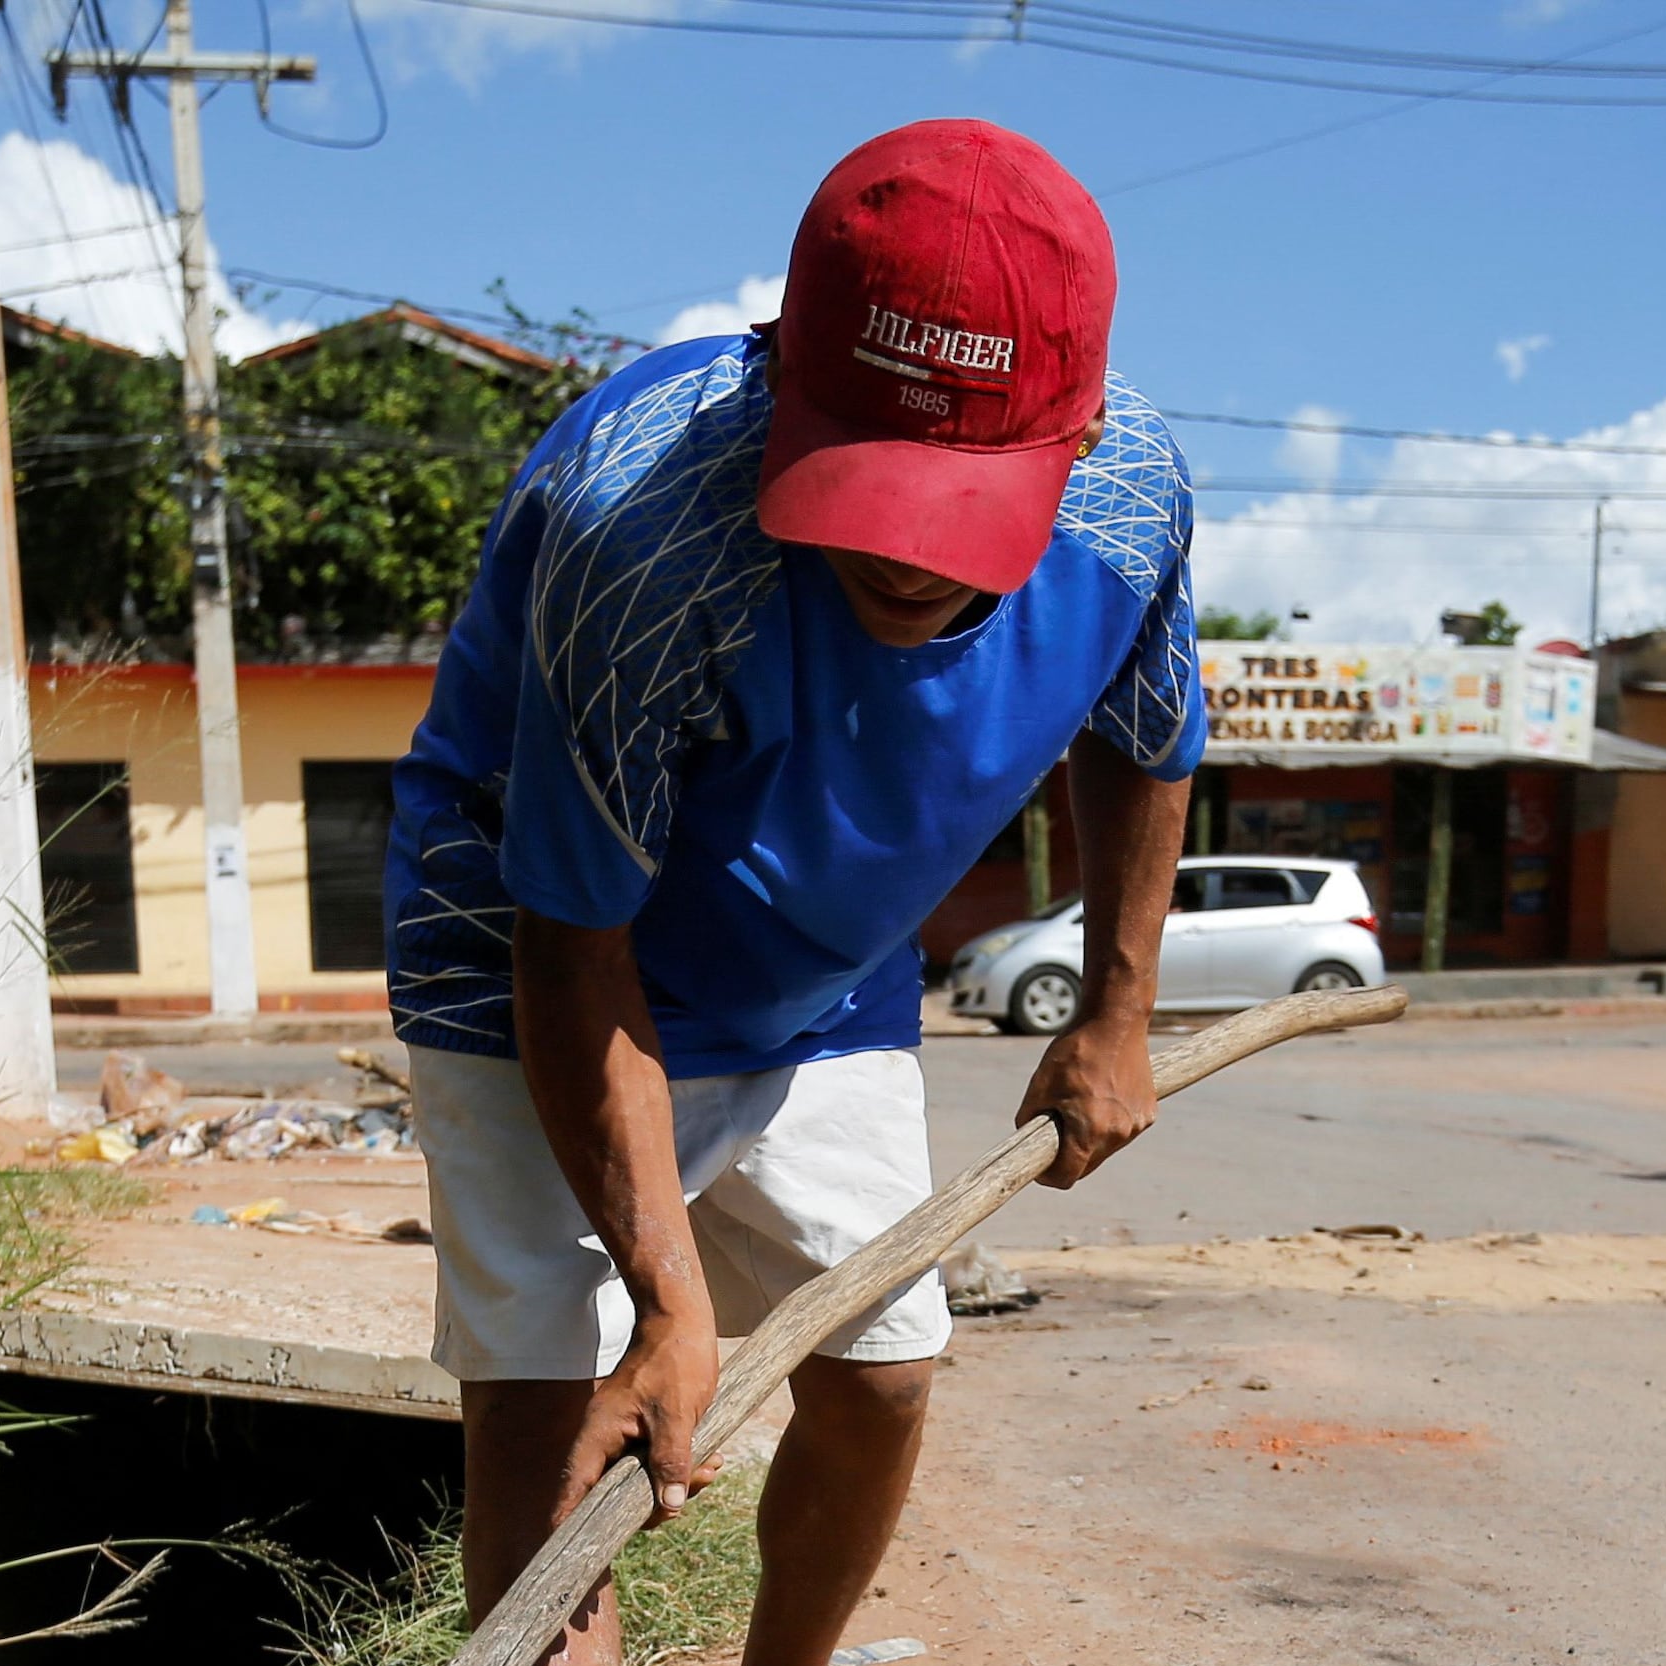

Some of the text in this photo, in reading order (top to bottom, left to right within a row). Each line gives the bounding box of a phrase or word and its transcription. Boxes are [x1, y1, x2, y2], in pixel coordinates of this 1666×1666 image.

[861, 304, 1014, 373] HILFIGER
[899, 384, 951, 416] 1985
[1241, 656, 1318, 678] TRES
[1203, 687, 1371, 711] RONTERAS
[1280, 718, 1294, 740] &
[1305, 719, 1397, 741] BODEGA
